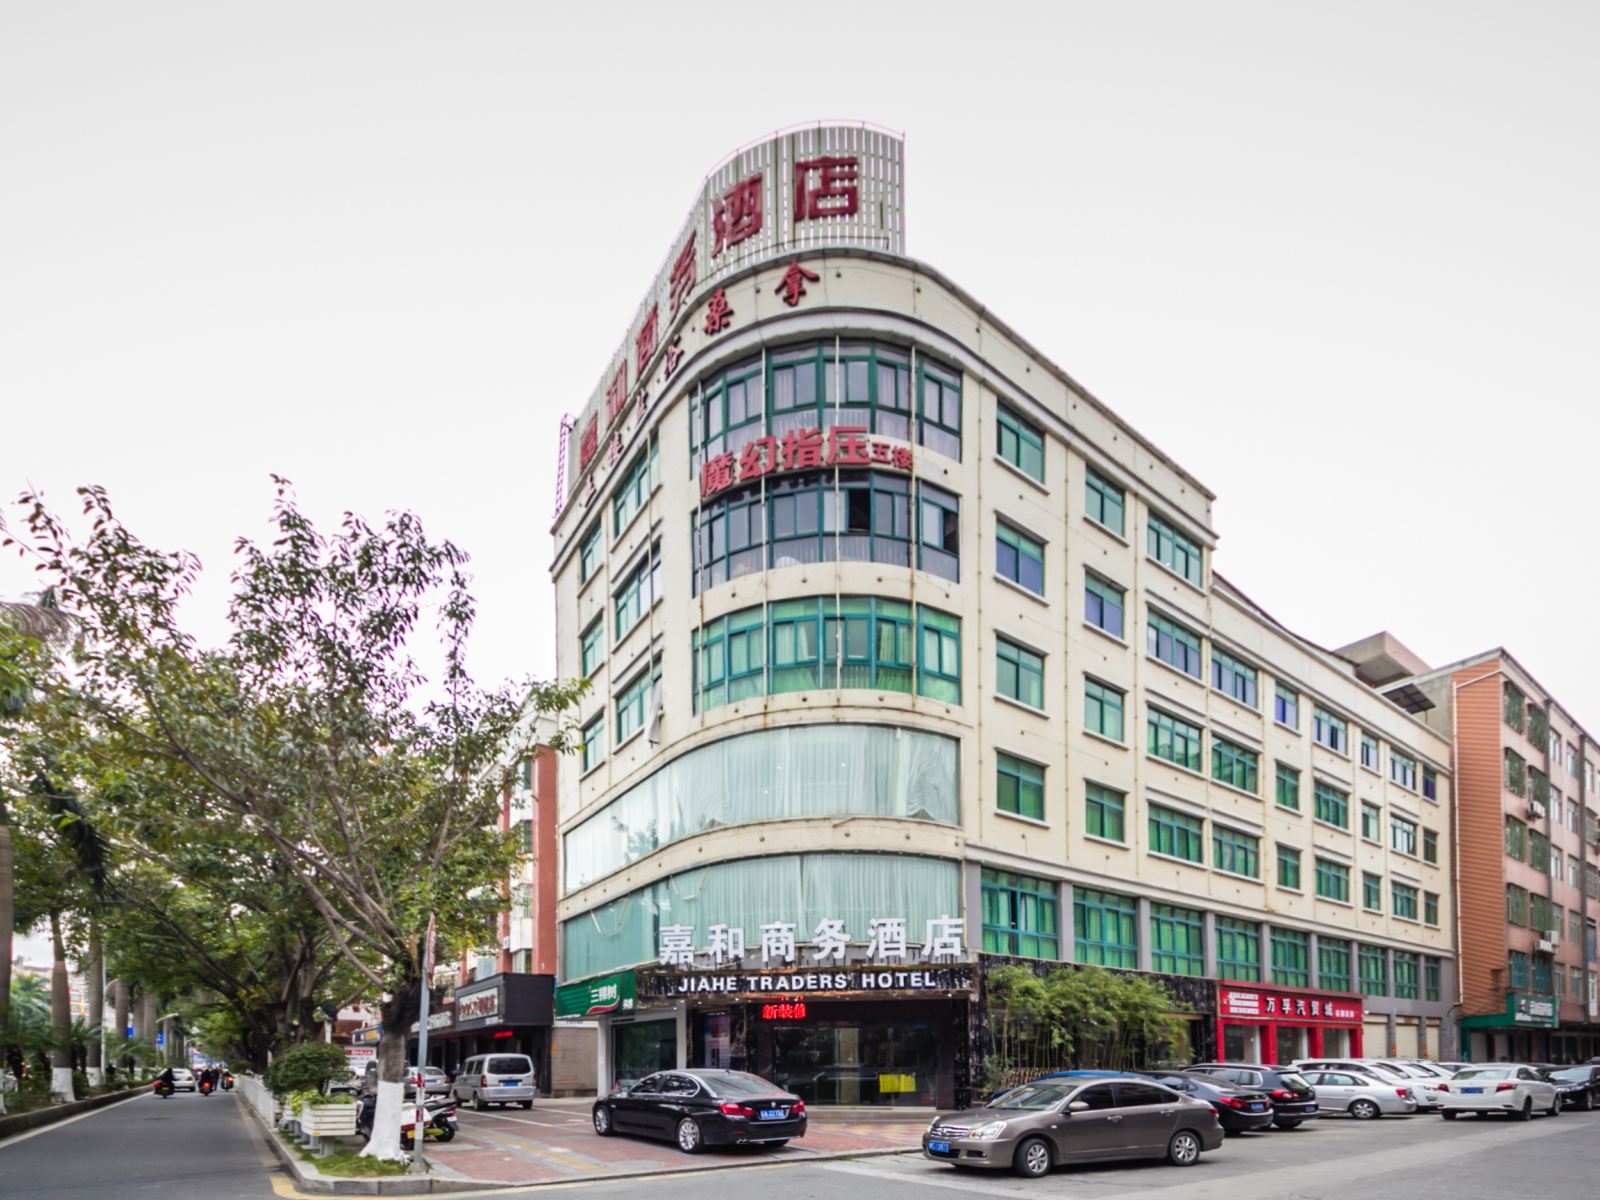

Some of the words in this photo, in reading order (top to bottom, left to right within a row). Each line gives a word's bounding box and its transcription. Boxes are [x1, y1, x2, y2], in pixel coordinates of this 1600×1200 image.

[659, 916, 964, 966] 嘉和商务酒店
[678, 976, 737, 992] JIAHE
[750, 973, 848, 990] TRADERS
[861, 970, 936, 989] HOTEL
